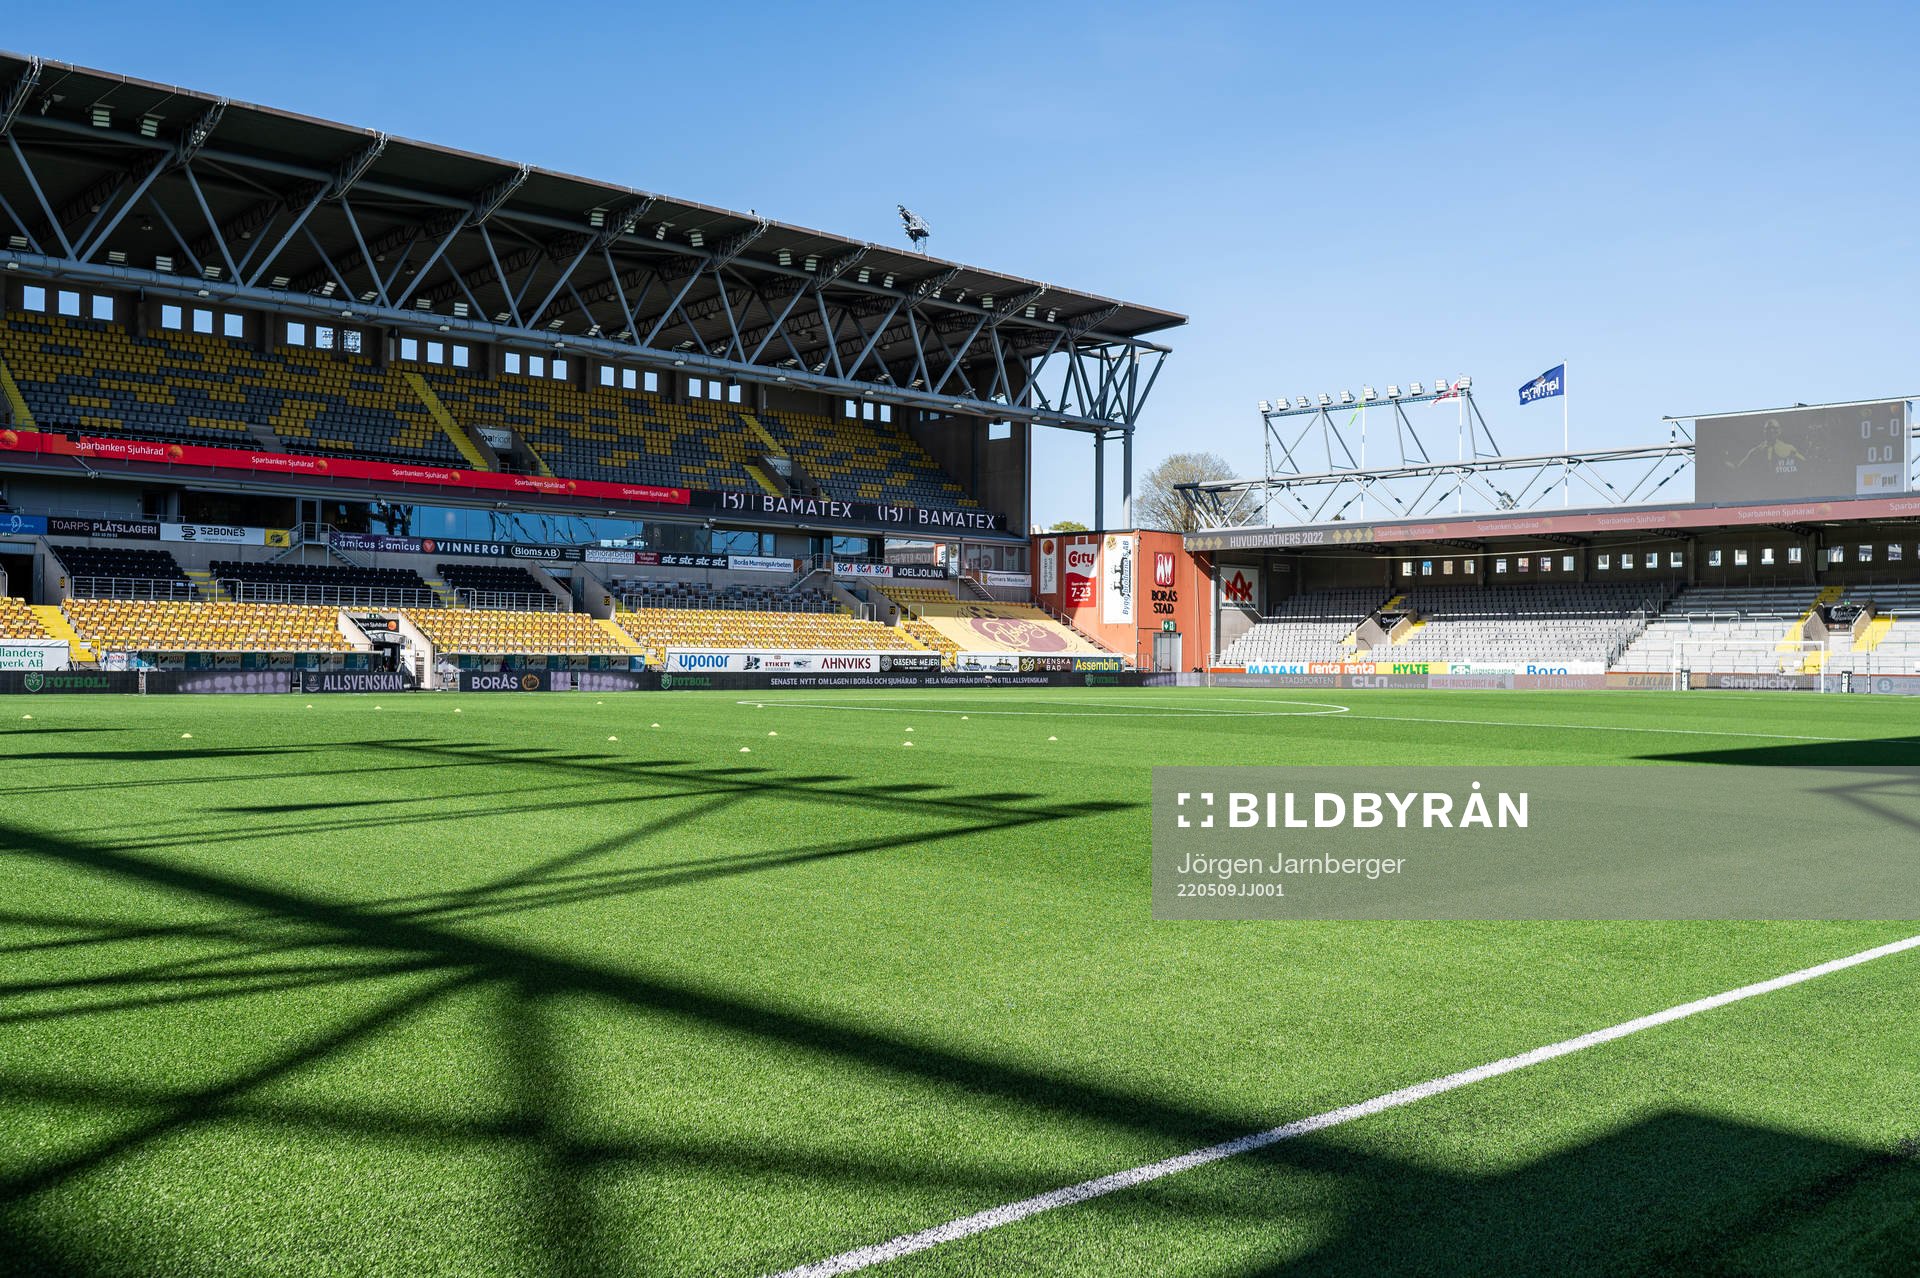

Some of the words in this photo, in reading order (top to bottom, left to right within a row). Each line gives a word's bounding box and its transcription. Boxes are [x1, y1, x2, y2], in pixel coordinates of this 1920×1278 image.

[75, 441, 125, 453] Sparbanken
[127, 443, 164, 456] Sjuhärad
[251, 456, 287, 467] Sparbanken
[287, 458, 314, 469] Sjuhärad
[392, 469, 424, 478] Sparbanken
[515, 479, 543, 488] Sparbanken
[622, 488, 648, 496] Sparbanken
[763, 496, 852, 518] BAMATEX
[919, 509, 995, 529] BAMATEX
[1738, 510, 1781, 520] Sparbanken
[1477, 522, 1511, 532] Sparbanken
[1599, 517, 1635, 526] Sparbanken
[51, 520, 90, 531] TOARPS
[92, 520, 157, 535] PLÅTSLAGERI
[200, 527, 246, 537] 52BONES
[339, 539, 376, 550] amicus
[1230, 531, 1301, 548] HUVUDPARTNERS
[1302, 531, 1324, 544] 2022
[385, 541, 421, 551] amicus
[437, 542, 505, 555] VINNERGI
[514, 546, 542, 557] Bloms
[543, 548, 557, 558] AB
[661, 554, 676, 564] stc
[678, 555, 693, 565] stc
[695, 556, 710, 566] stc
[712, 556, 726, 566] stc
[837, 564, 852, 572] SGA
[856, 564, 871, 573] SGA
[875, 565, 890, 574] SGA
[897, 568, 944, 579] JOELJOLINA
[1225, 570, 1253, 602] MAX
[1071, 587, 1091, 597] 7-23
[1151, 590, 1178, 602] BORÅS
[1153, 603, 1174, 614] STAD
[28, 659, 43, 668] AB
[679, 655, 730, 671] uponor
[821, 657, 871, 669] AHNVIKS
[919, 658, 940, 666] MEJERI
[1075, 658, 1119, 671] Assemblin
[1311, 663, 1341, 674] renta
[1344, 663, 1375, 674] renta
[1393, 663, 1429, 675] HYLTE
[45, 676, 110, 688] FOTBOLL
[323, 674, 403, 691] ALLSVENSKAN
[472, 674, 518, 689] BORÅS
[771, 678, 798, 686] SENASTE
[853, 676, 874, 685] BORÅS
[888, 676, 917, 686] SJUHÄRAD
[940, 676, 958, 685] VÄGEN
[958, 676, 973, 685] FRÅN
[1280, 676, 1334, 685] STADSPORTEN
